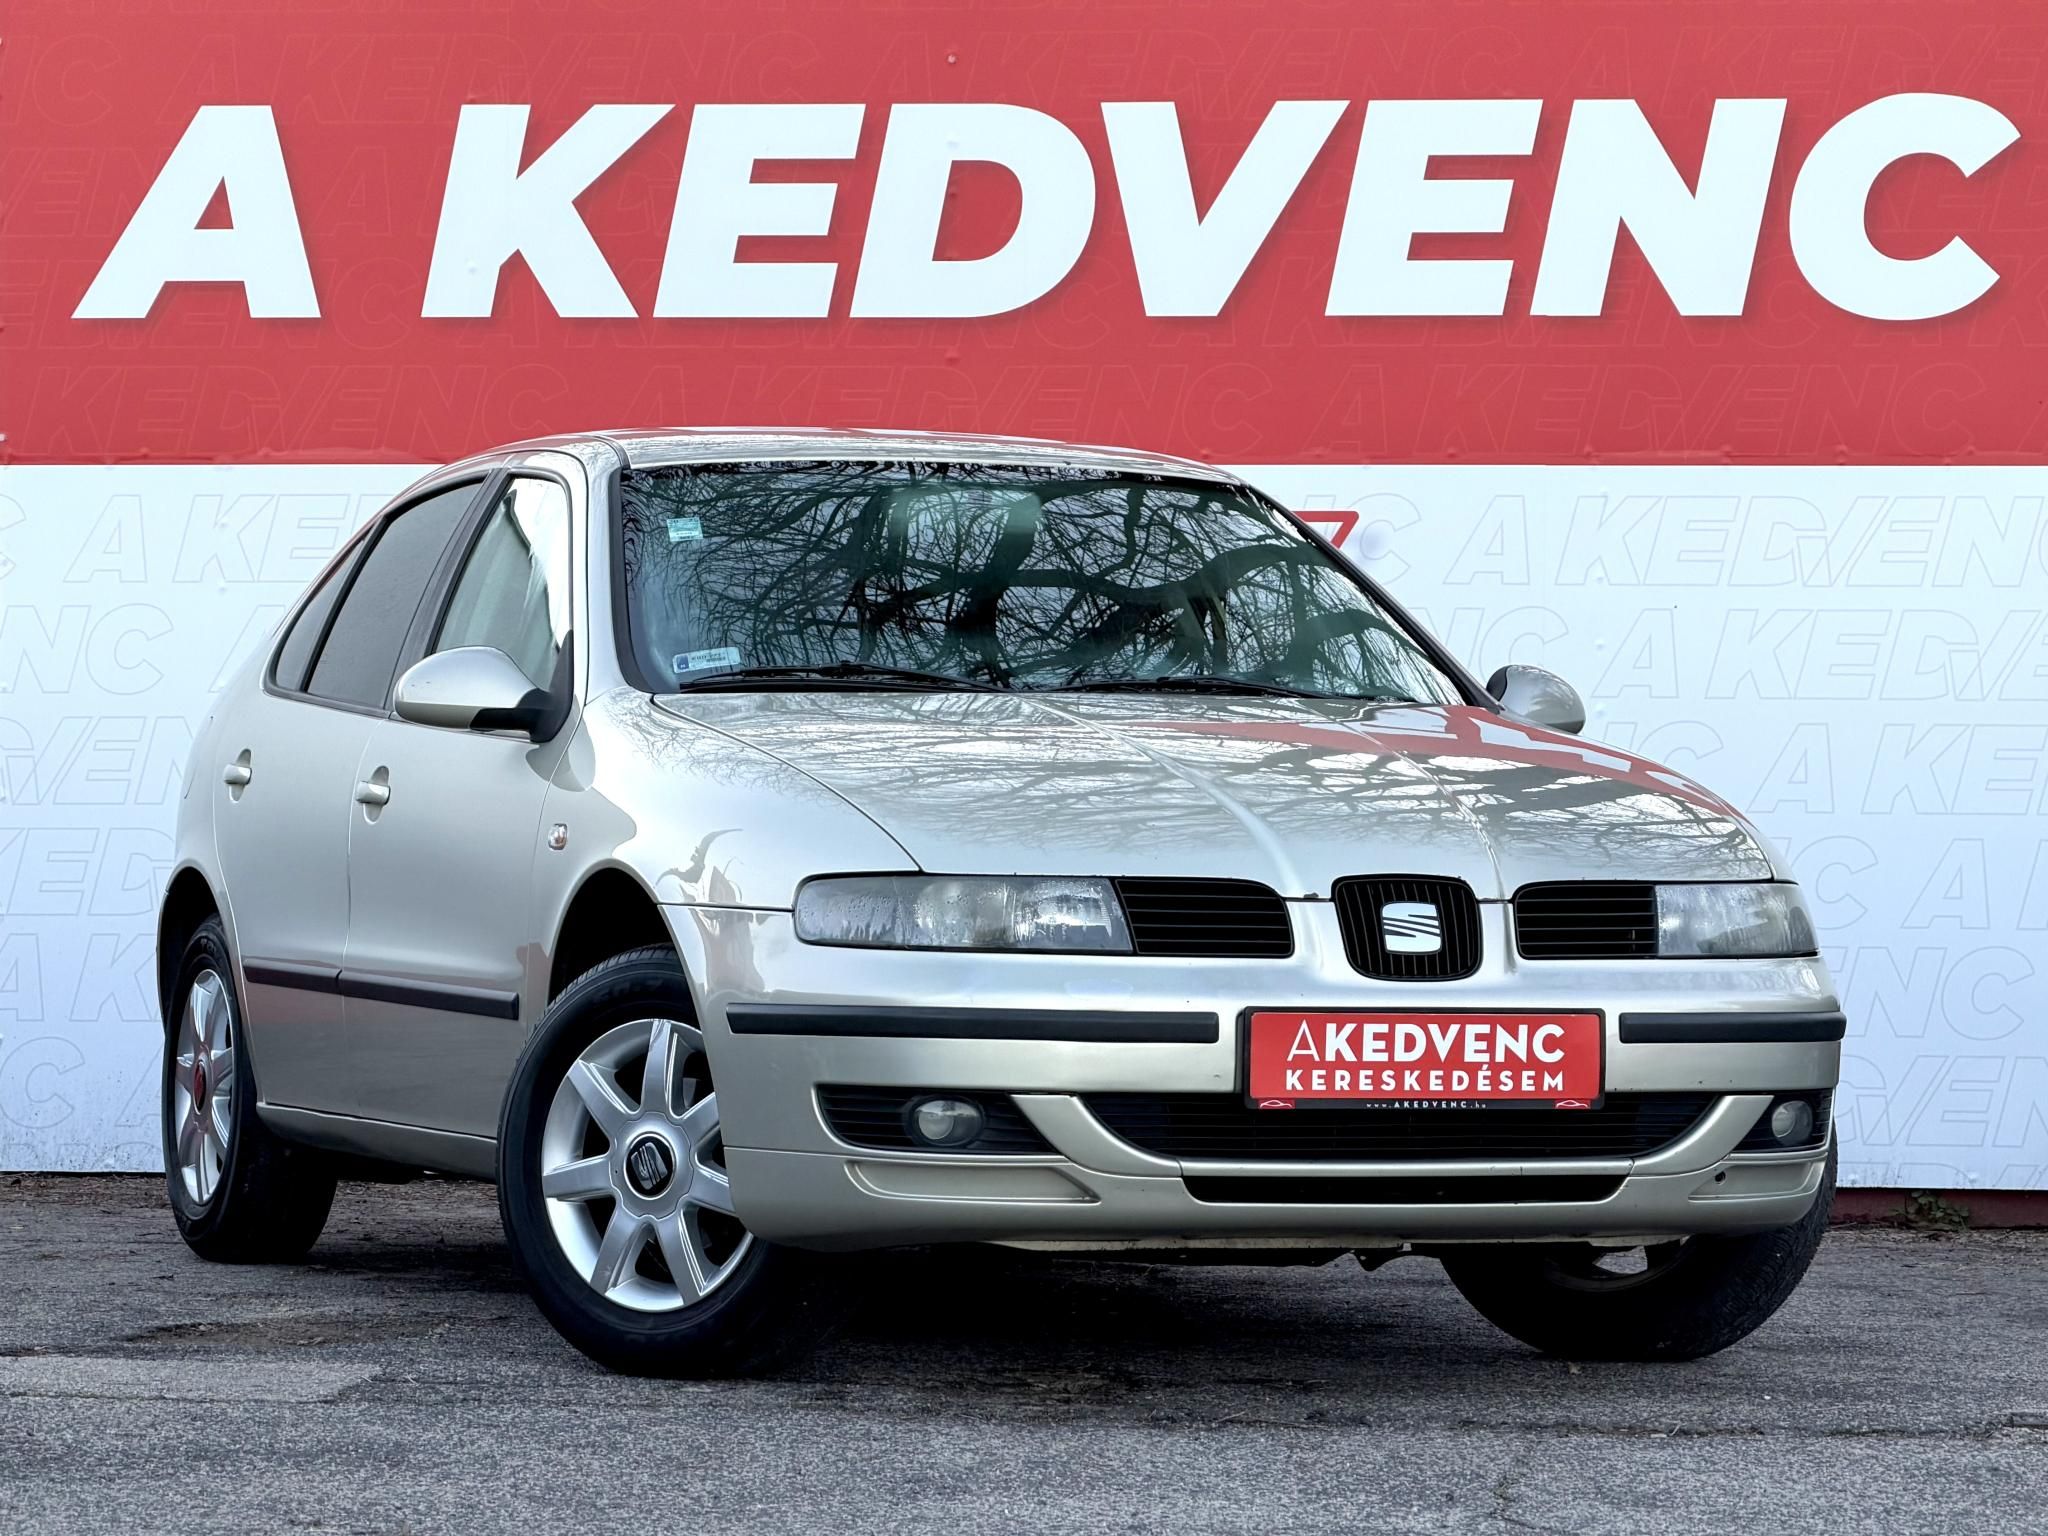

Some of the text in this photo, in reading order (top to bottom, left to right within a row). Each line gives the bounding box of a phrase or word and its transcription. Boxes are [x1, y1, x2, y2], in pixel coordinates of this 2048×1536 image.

[71, 104, 321, 318] A
[421, 92, 2019, 319] KEDVENC
[1285, 1063, 1564, 1092] KERESKEDÉSEM
